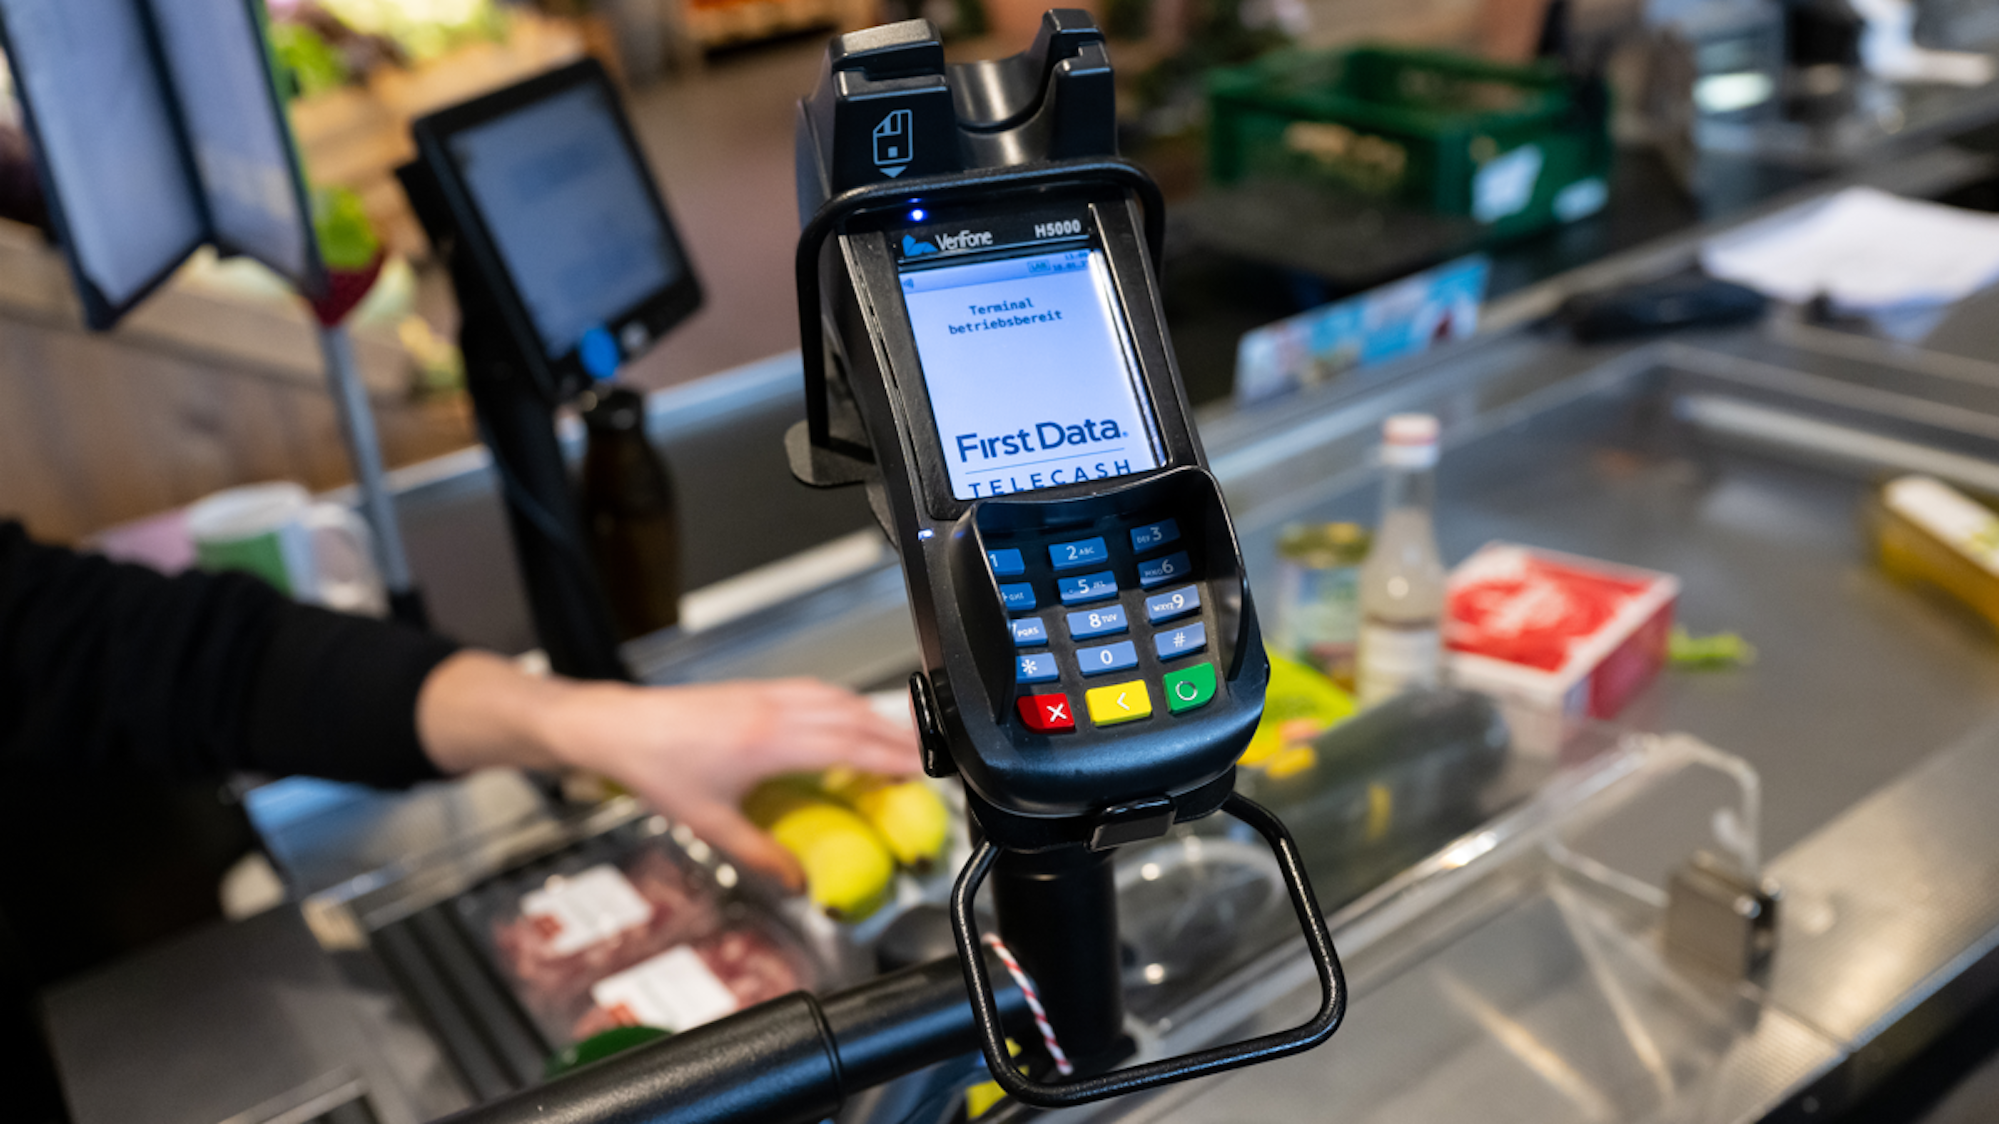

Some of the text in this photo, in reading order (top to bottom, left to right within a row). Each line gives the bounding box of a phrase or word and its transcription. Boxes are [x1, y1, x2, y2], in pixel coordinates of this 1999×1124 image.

[935, 219, 1082, 251] VeriFone H5000
[968, 298, 1035, 316] Terminal
[948, 310, 1063, 335] betriebsbereit
[955, 429, 1035, 463] First
[968, 459, 1132, 499] TELECASH
[1150, 526, 1162, 541] 3
[989, 553, 999, 567] 1
[1066, 545, 1078, 560] 2
[1162, 559, 1174, 574] 6
[1078, 579, 1090, 594] 5
[1172, 593, 1185, 609] 9
[1089, 613, 1102, 628] 8
